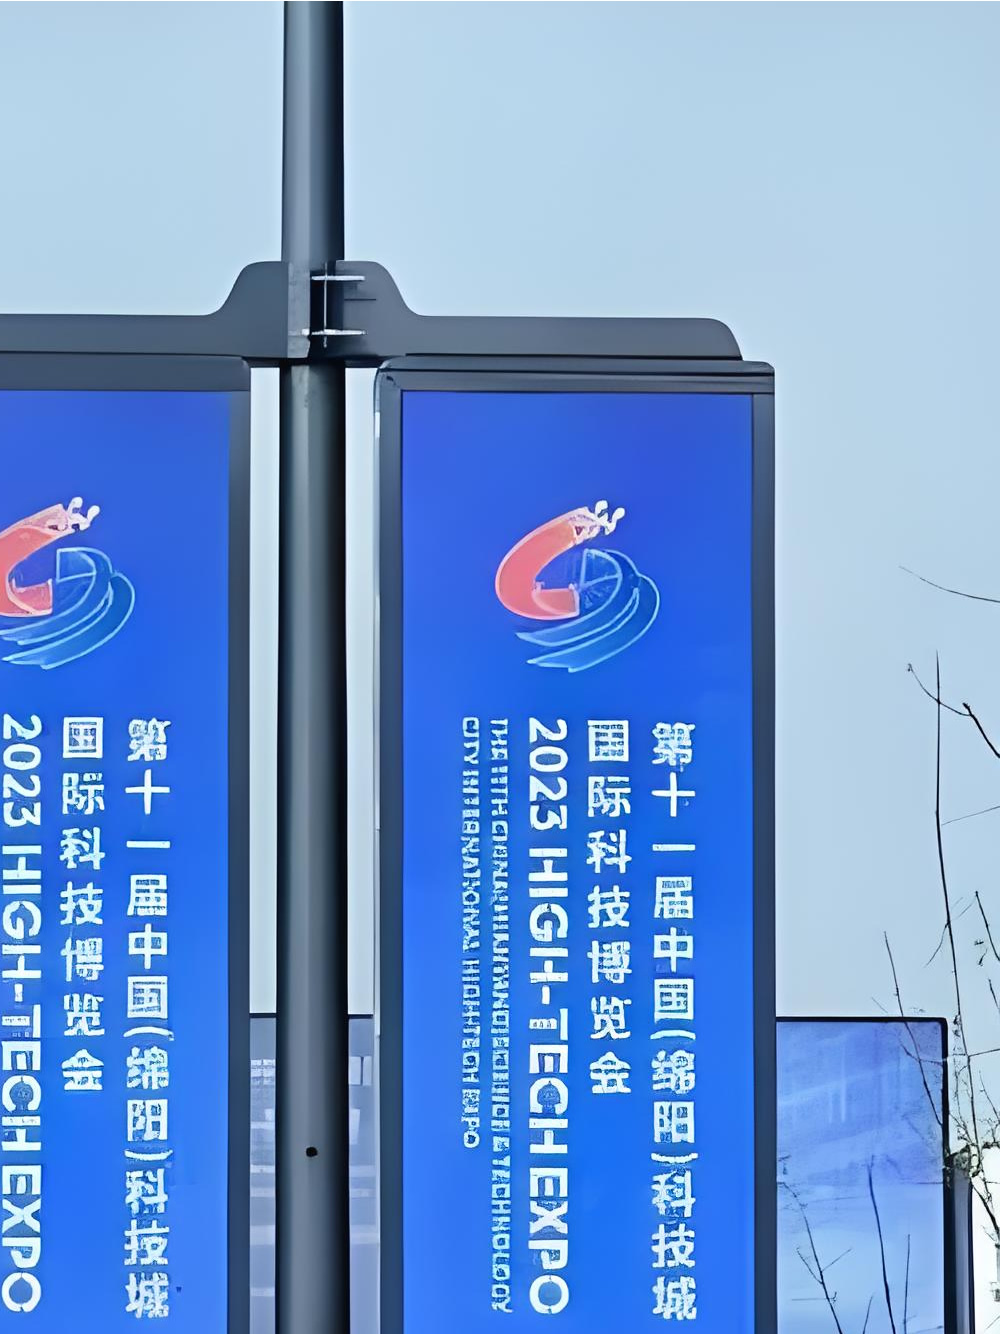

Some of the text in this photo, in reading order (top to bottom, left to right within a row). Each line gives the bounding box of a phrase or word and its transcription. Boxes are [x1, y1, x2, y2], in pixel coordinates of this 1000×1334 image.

[1, 713, 42, 1314] 2023 HIGH-TECH EXPO
[60, 716, 105, 1092] 国际科技博览会
[528, 717, 569, 1315] 2023 HIGH-TECH EXPO
[586, 719, 632, 1094] 国际科技博览会
